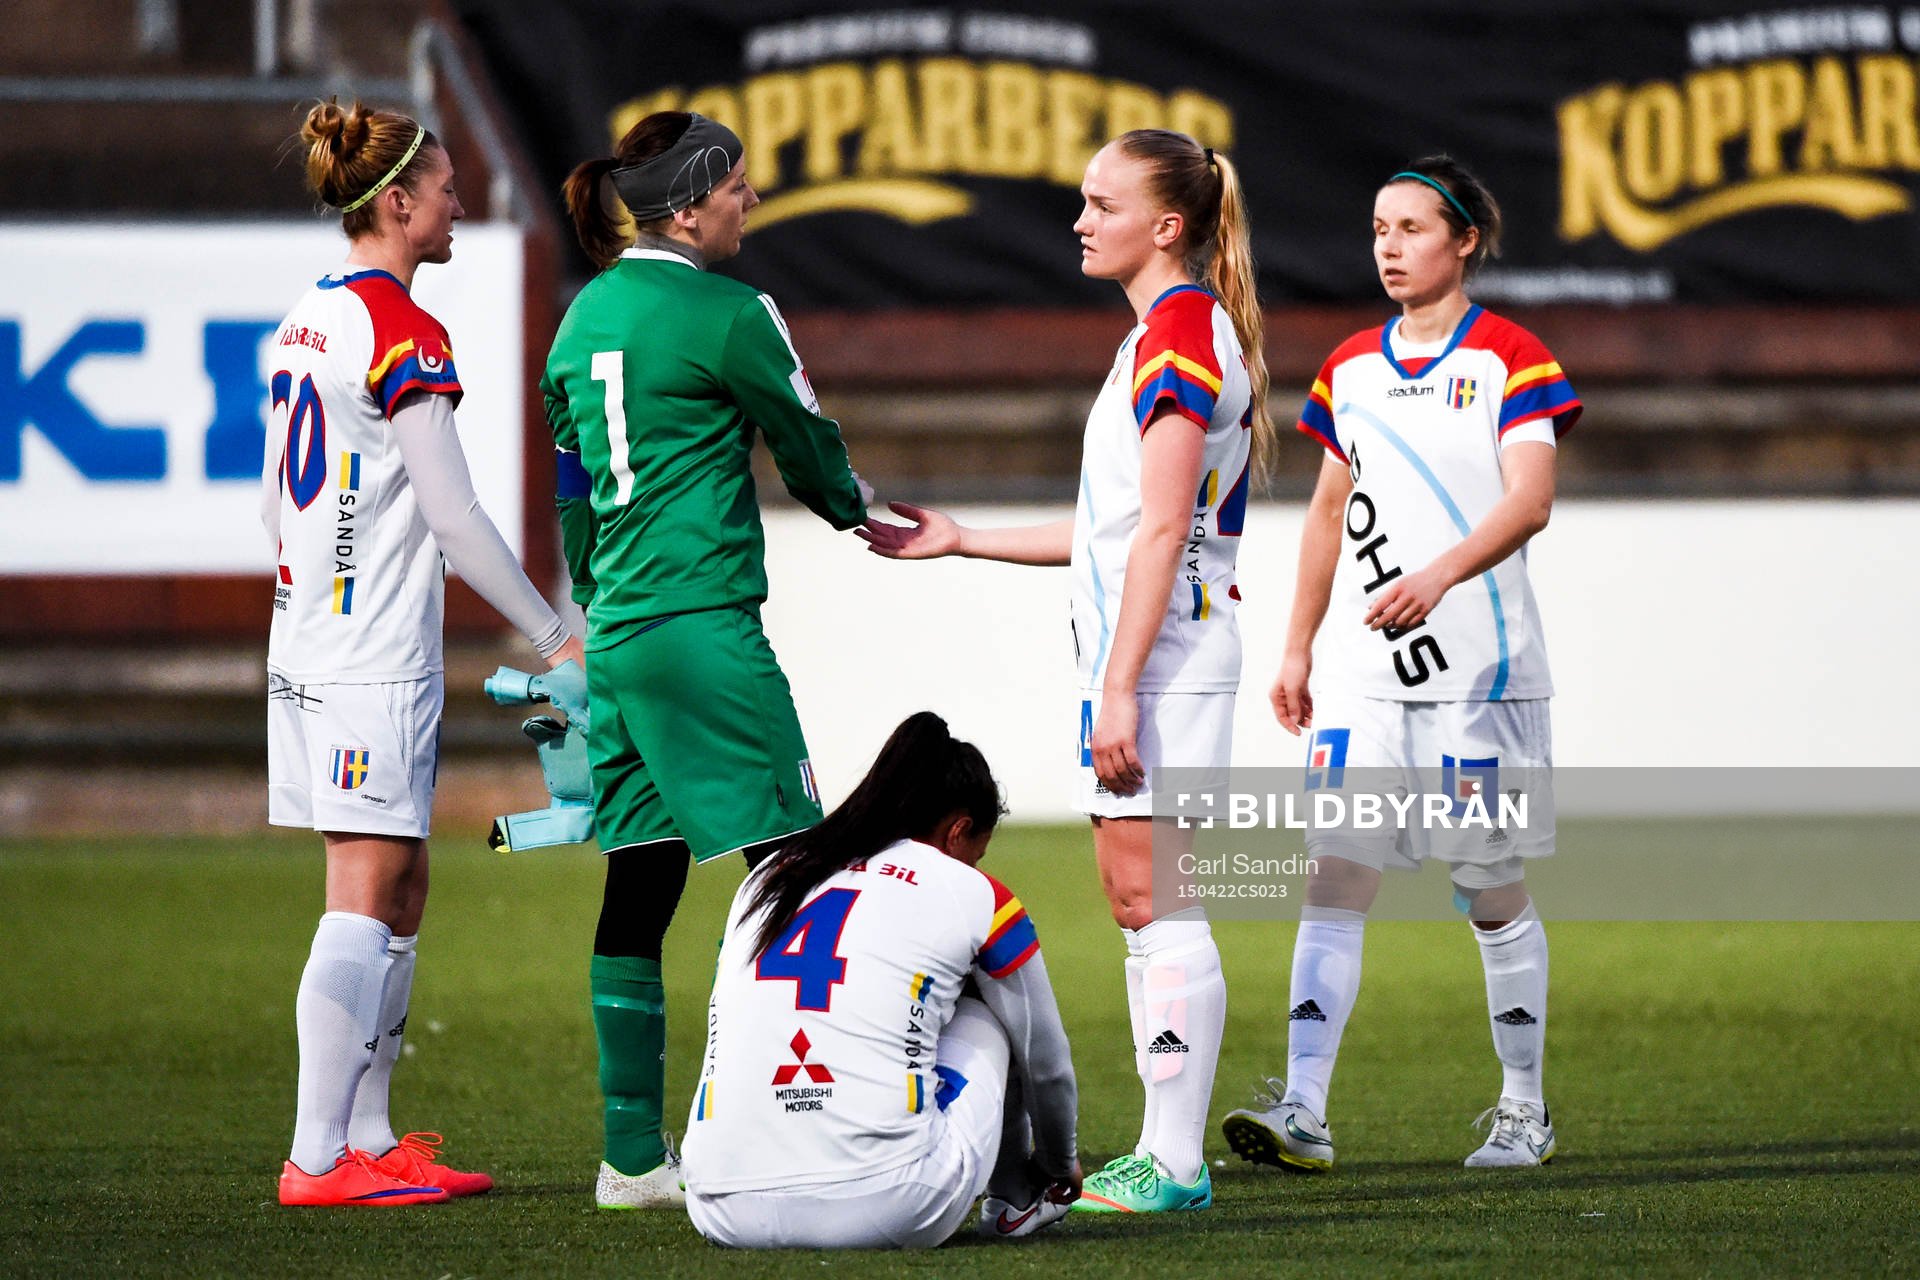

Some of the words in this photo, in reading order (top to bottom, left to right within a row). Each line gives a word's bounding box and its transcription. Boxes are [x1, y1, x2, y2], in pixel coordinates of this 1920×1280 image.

[608, 57, 1236, 245] PPARBE
[590, 350, 635, 504] 1
[1387, 385, 1434, 398] stadium
[335, 494, 357, 573] SANDÅ
[1346, 439, 1450, 688] BOHS
[755, 887, 862, 1012] 4
[1148, 1043, 1190, 1054] adidas
[775, 1088, 832, 1100] MITSUBISHI
[785, 1100, 823, 1112] MOTORS
